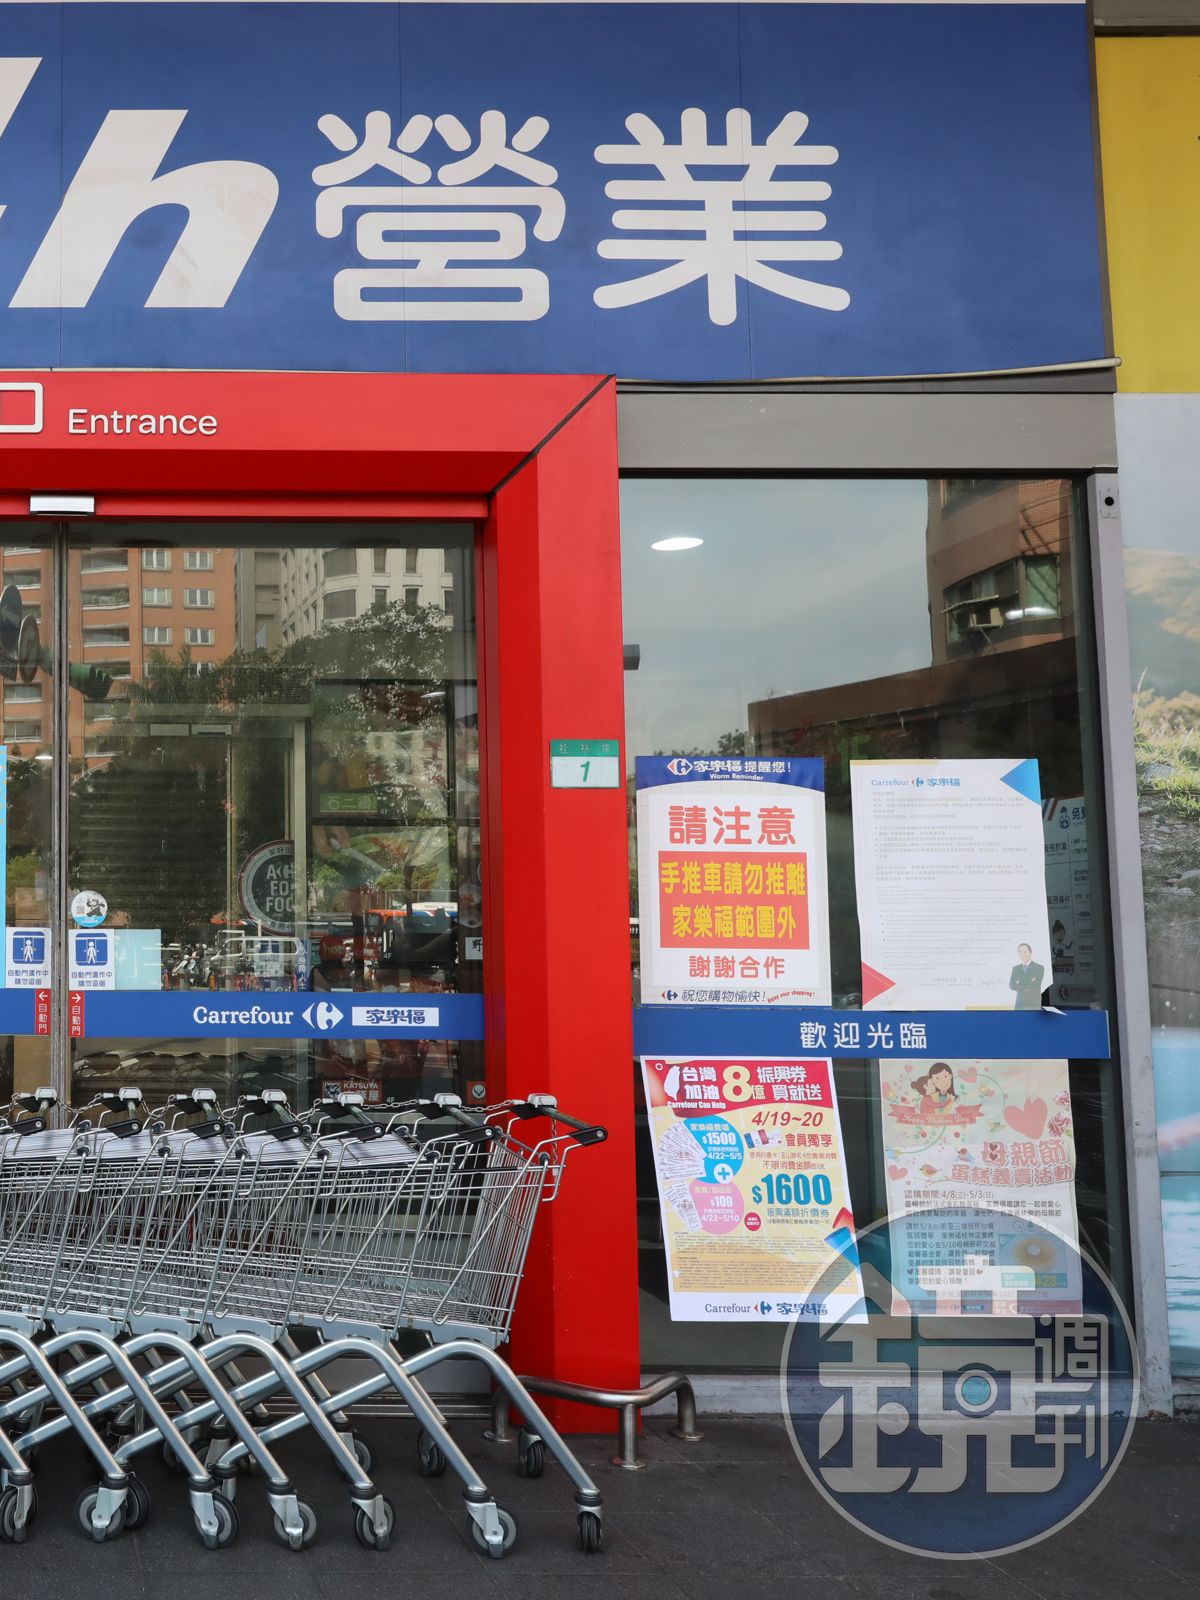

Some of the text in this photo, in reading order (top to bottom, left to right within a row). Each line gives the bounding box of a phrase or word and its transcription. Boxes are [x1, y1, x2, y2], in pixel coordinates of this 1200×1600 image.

[311, 107, 851, 326] 營業
[68, 407, 218, 436] Entrance
[580, 761, 590, 782] 1
[694, 760, 743, 773] 家樂福
[871, 777, 961, 787] Carrefour 家樂福
[668, 805, 797, 846] 請注意
[660, 861, 807, 896] 手推車請勿推離
[672, 904, 798, 940] 家樂福範圍外
[7, 969, 49, 977] 自動門運作中
[71, 971, 113, 979] 自動門運作中
[688, 955, 786, 979] 謝謝合作
[38, 1003, 48, 1033] 自動門
[71, 1006, 81, 1035] 自動門
[193, 1006, 426, 1026] Carrefour 家樂福
[800, 1021, 928, 1050] 歡迎光臨
[681, 1066, 717, 1082] 台灣
[756, 1065, 807, 1083] 振興券
[343, 1082, 379, 1090] KATSUYA
[684, 1083, 823, 1101] 加油 買就送
[667, 1101, 726, 1110] Carrefour Can Help
[751, 1111, 824, 1127] 4/19~20
[701, 1131, 737, 1146] $1500
[785, 1133, 833, 1148] 會員獨享
[707, 1151, 743, 1161] 4/22~5/5
[981, 1138, 1070, 1168] 母親節
[951, 1164, 1074, 1188] 蛋糕義賣活動
[751, 1173, 833, 1206] $1600
[710, 1195, 734, 1208] $100
[704, 1302, 828, 1316] Carrefour 家樂福
